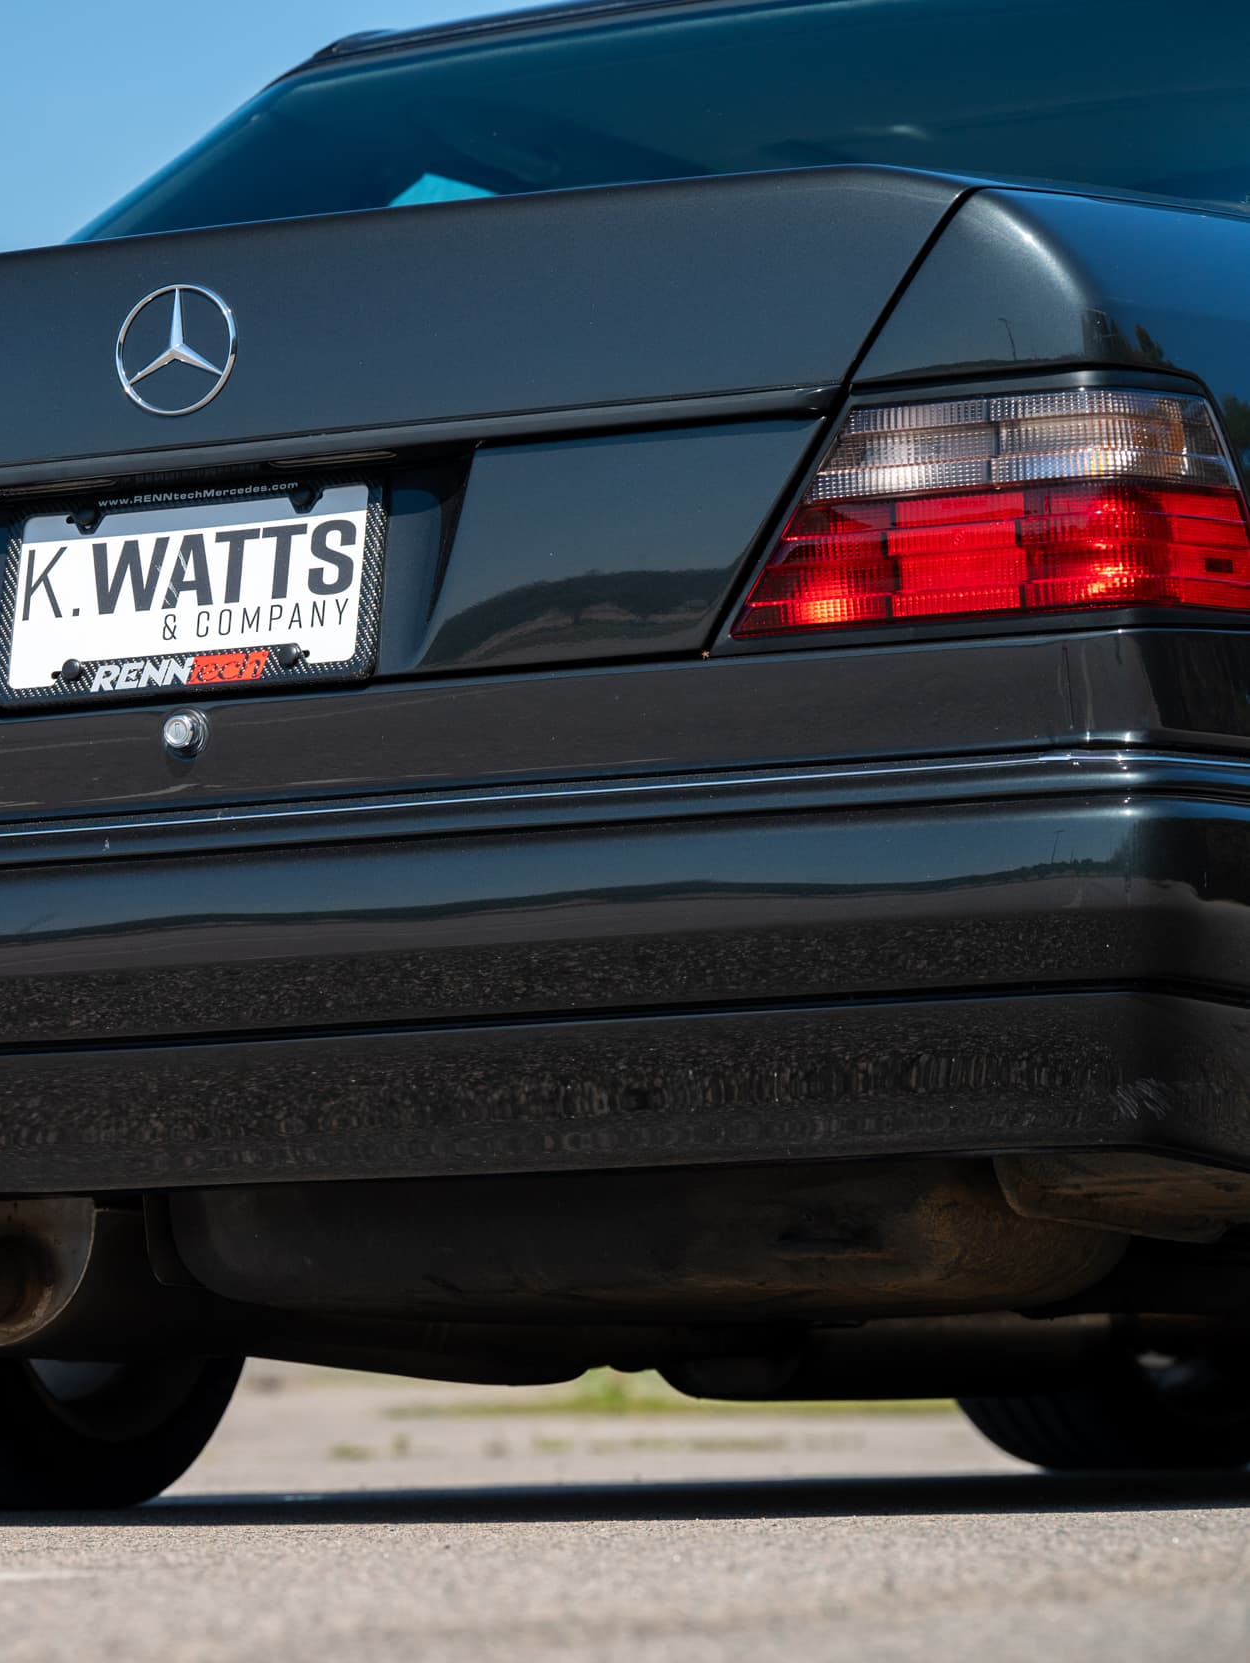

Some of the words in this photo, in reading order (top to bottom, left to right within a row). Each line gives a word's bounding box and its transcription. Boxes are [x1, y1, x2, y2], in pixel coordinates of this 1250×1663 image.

[98, 481, 299, 507] www.RENNtechMercedes.com
[162, 613, 178, 640] &
[196, 598, 349, 638] COMPANY
